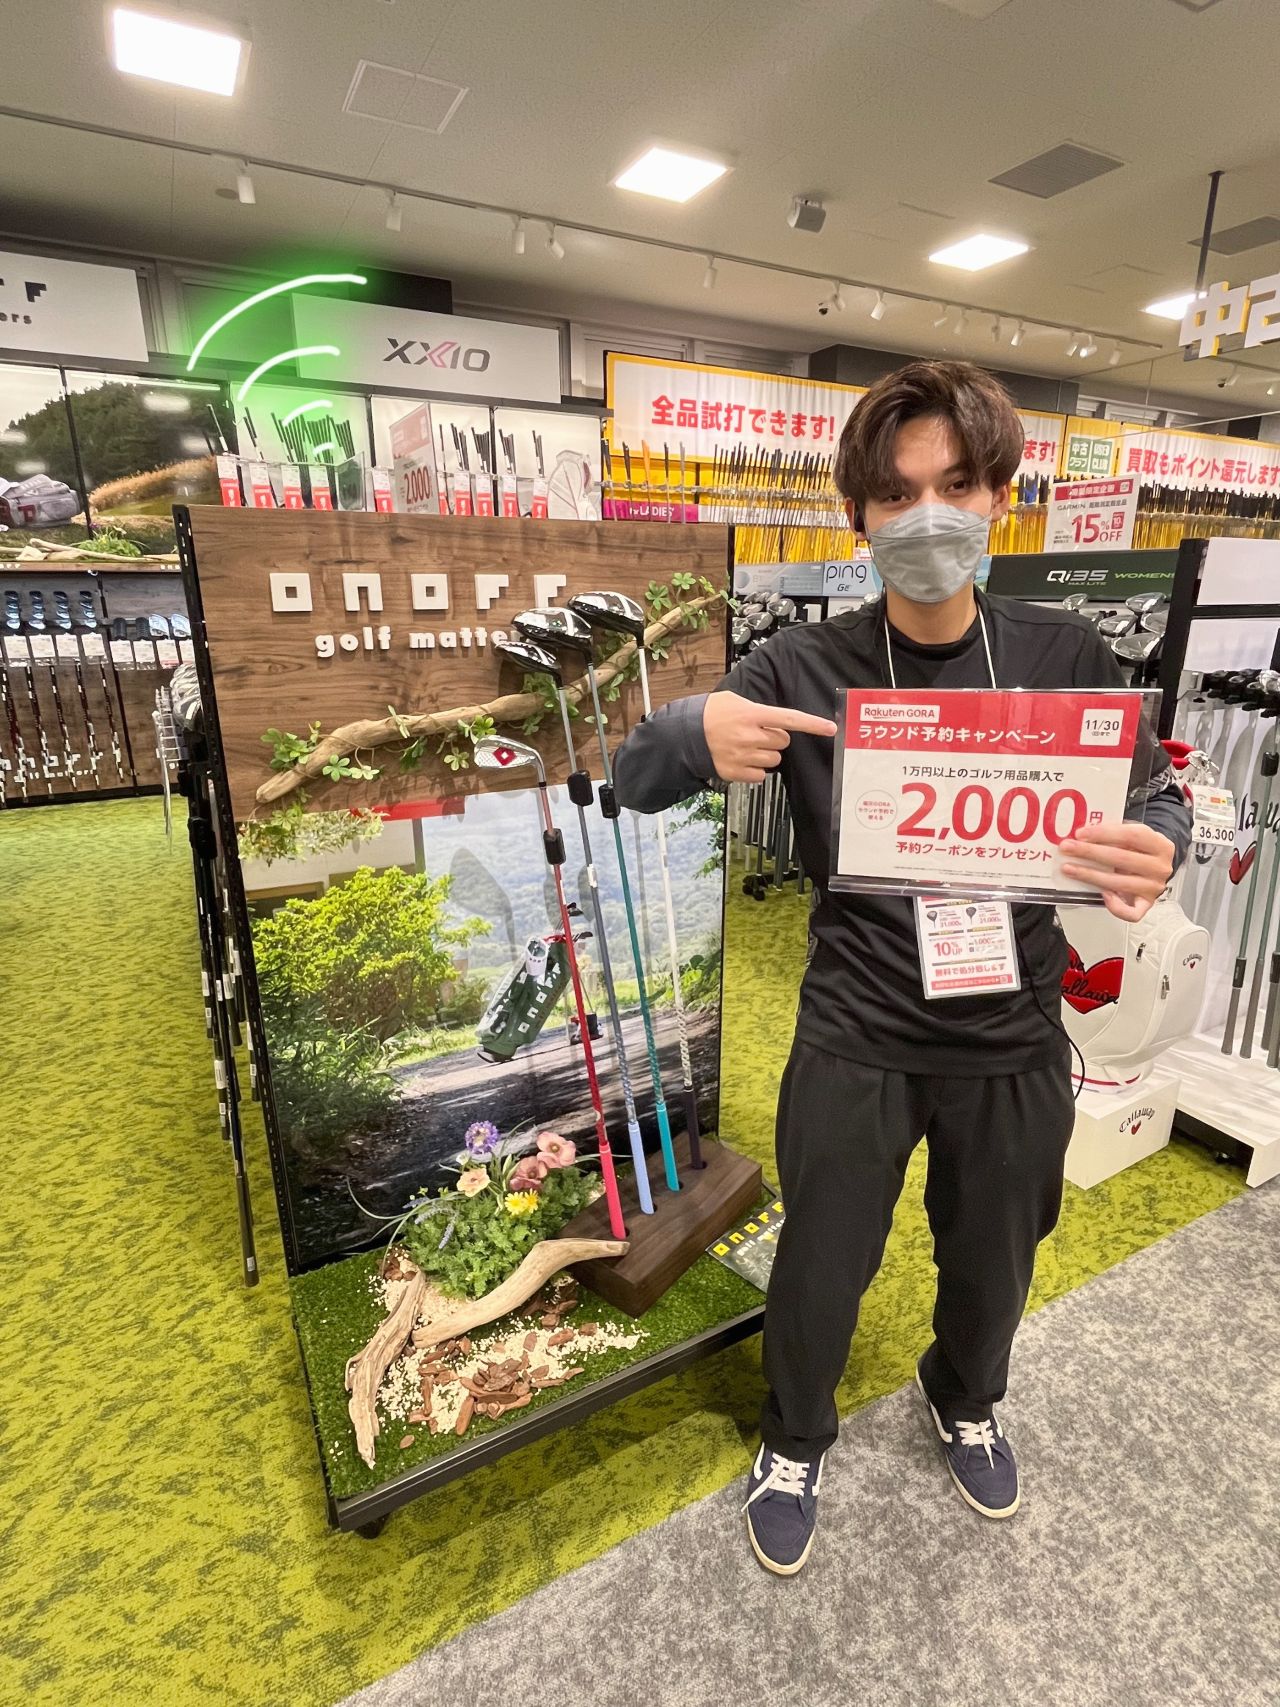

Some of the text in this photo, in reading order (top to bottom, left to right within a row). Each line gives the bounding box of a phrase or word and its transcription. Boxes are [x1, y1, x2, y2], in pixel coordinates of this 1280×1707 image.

[651, 395, 835, 442] 全品試打できます!
[1072, 513, 1101, 543] 15
[1099, 531, 1123, 543] OFF
[314, 625, 392, 658] golf
[864, 707, 935, 718] Rakuten GORA
[858, 724, 1056, 745] ラウンド予約キャンペーン
[1085, 719, 1120, 731] 11/30
[902, 765, 1064, 783] 1万円以上のゴルフ用品購入で
[896, 782, 1088, 846] 2,000
[896, 841, 1052, 862] 予約クーポンをプレゼント
[934, 941, 951, 956] 10
